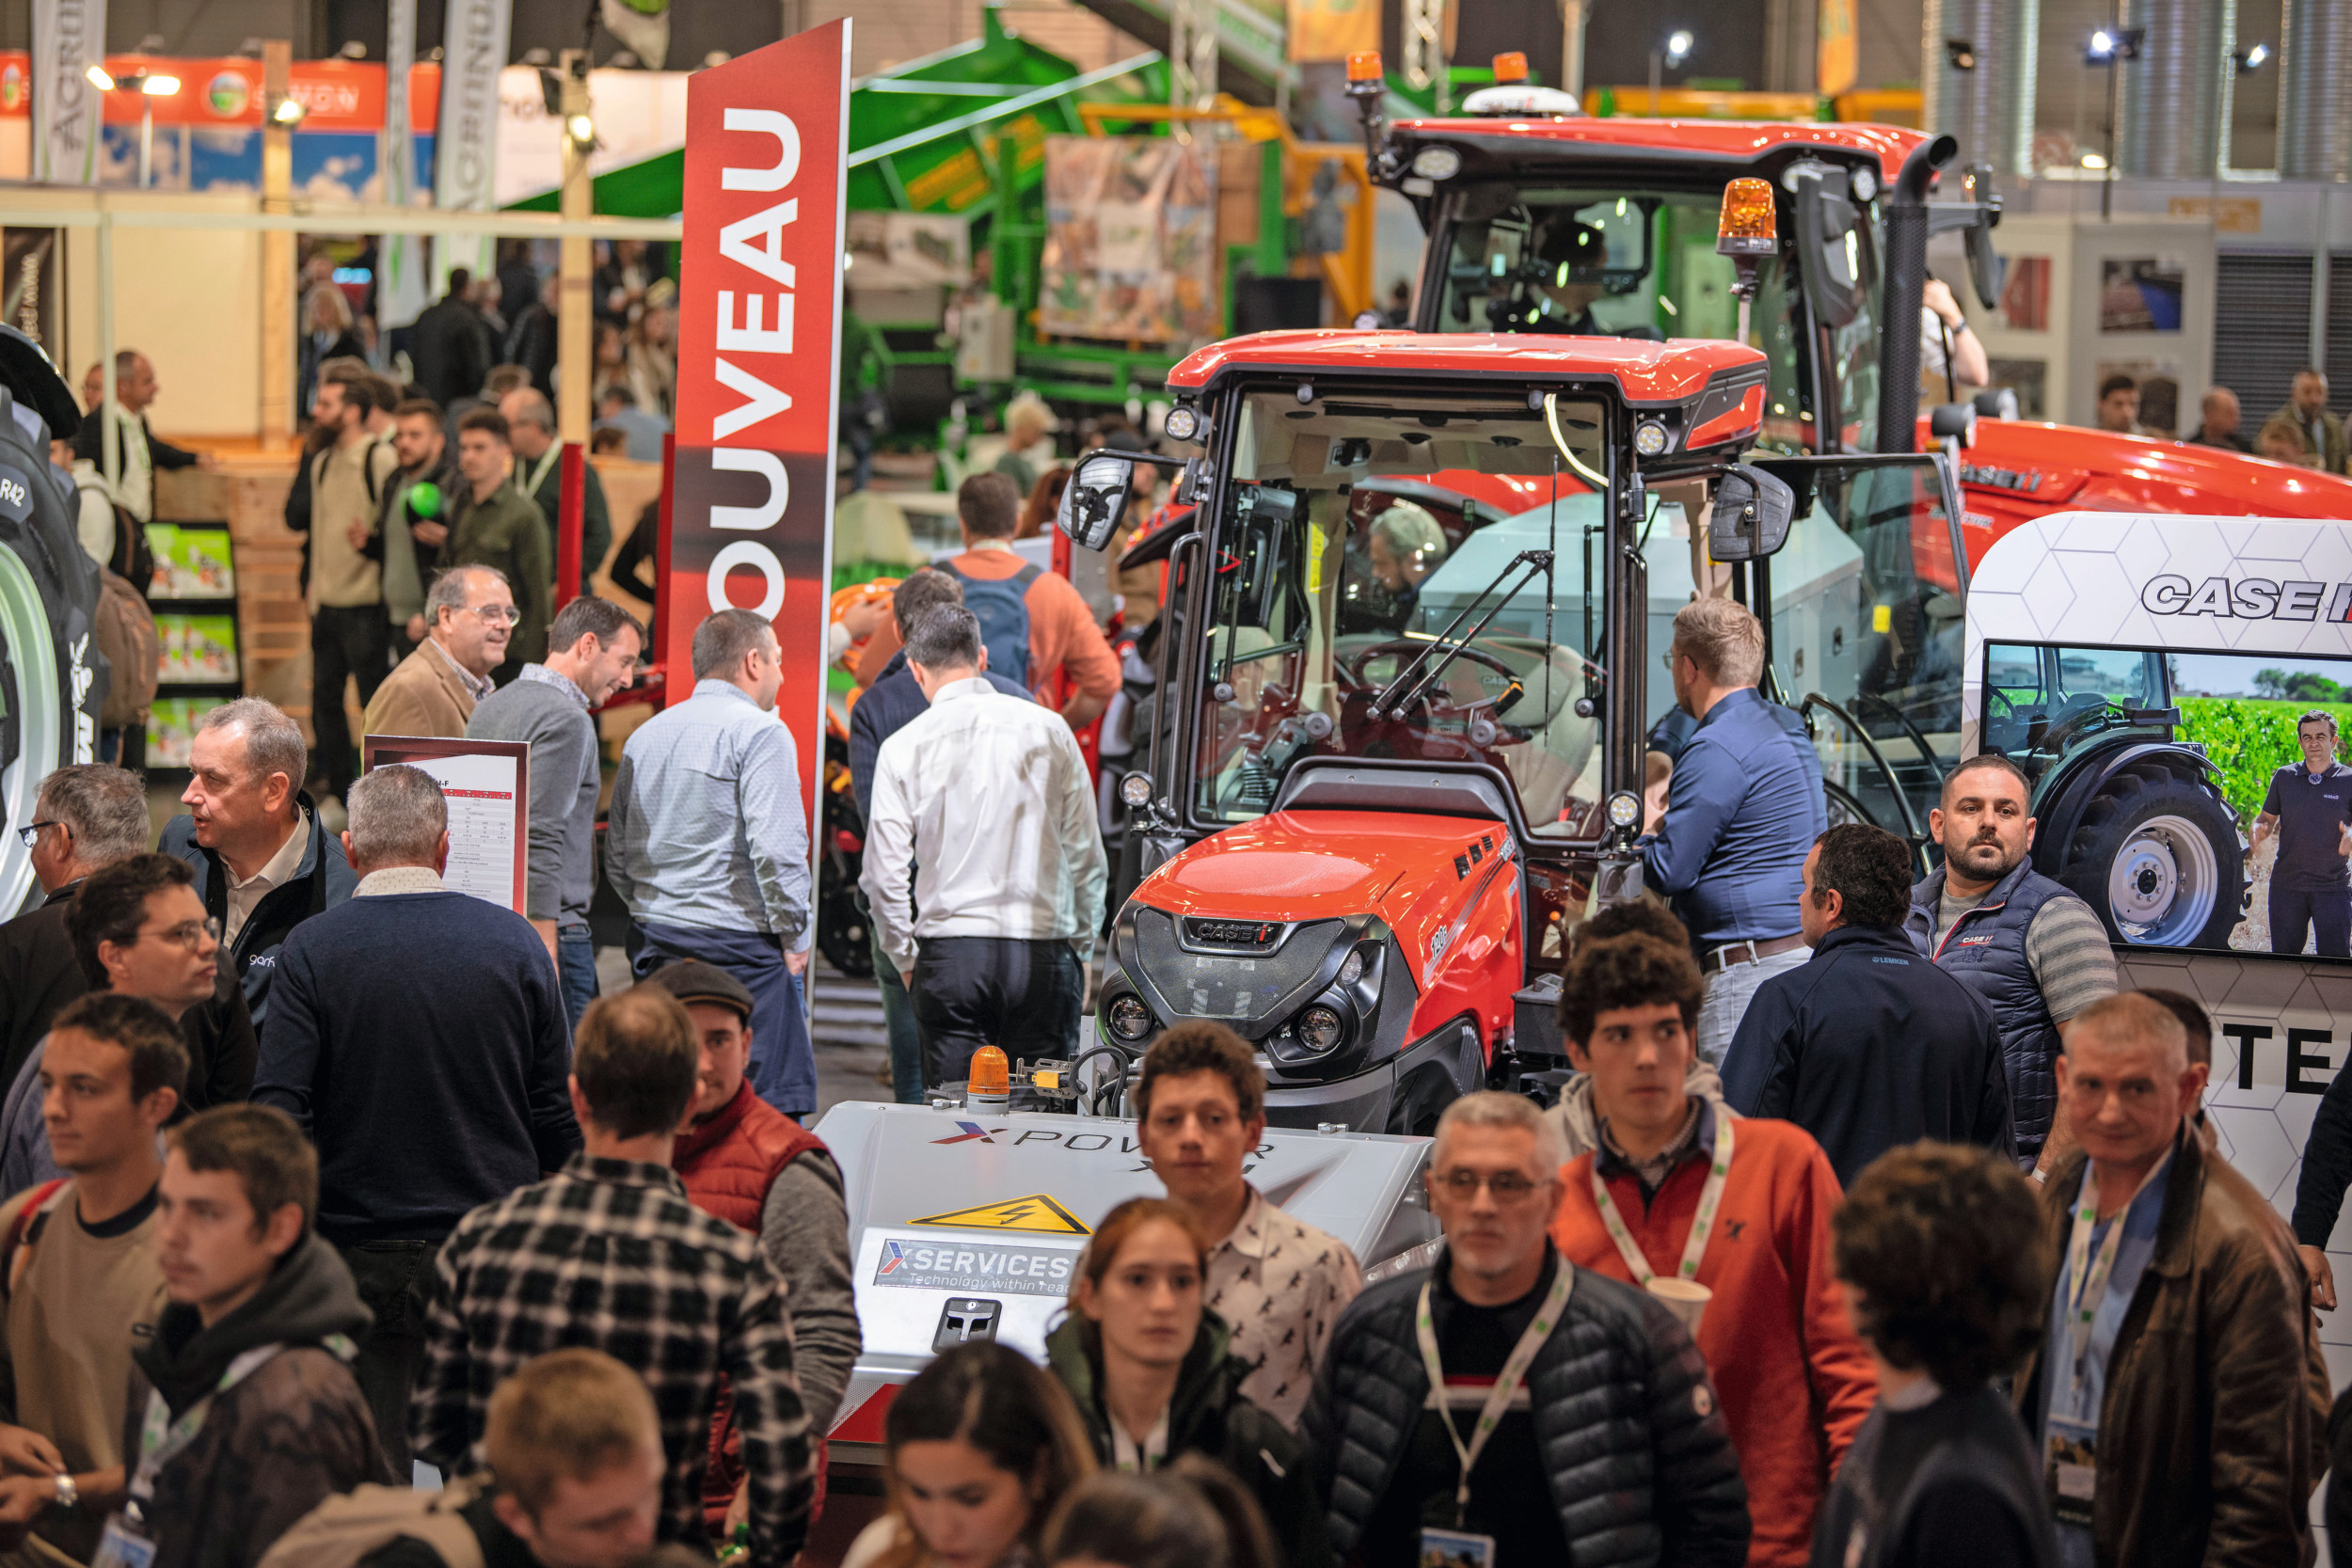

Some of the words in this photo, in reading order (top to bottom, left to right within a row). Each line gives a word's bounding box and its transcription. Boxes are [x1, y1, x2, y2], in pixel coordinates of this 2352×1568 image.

[252, 83, 360, 112] SMON
[707, 107, 802, 623] OUVEAU
[2141, 574, 2327, 622] CASE
[1880, 957, 1909, 966] LEMKEN
[910, 1273, 989, 1291] Technology
[992, 1277, 1036, 1291] within
